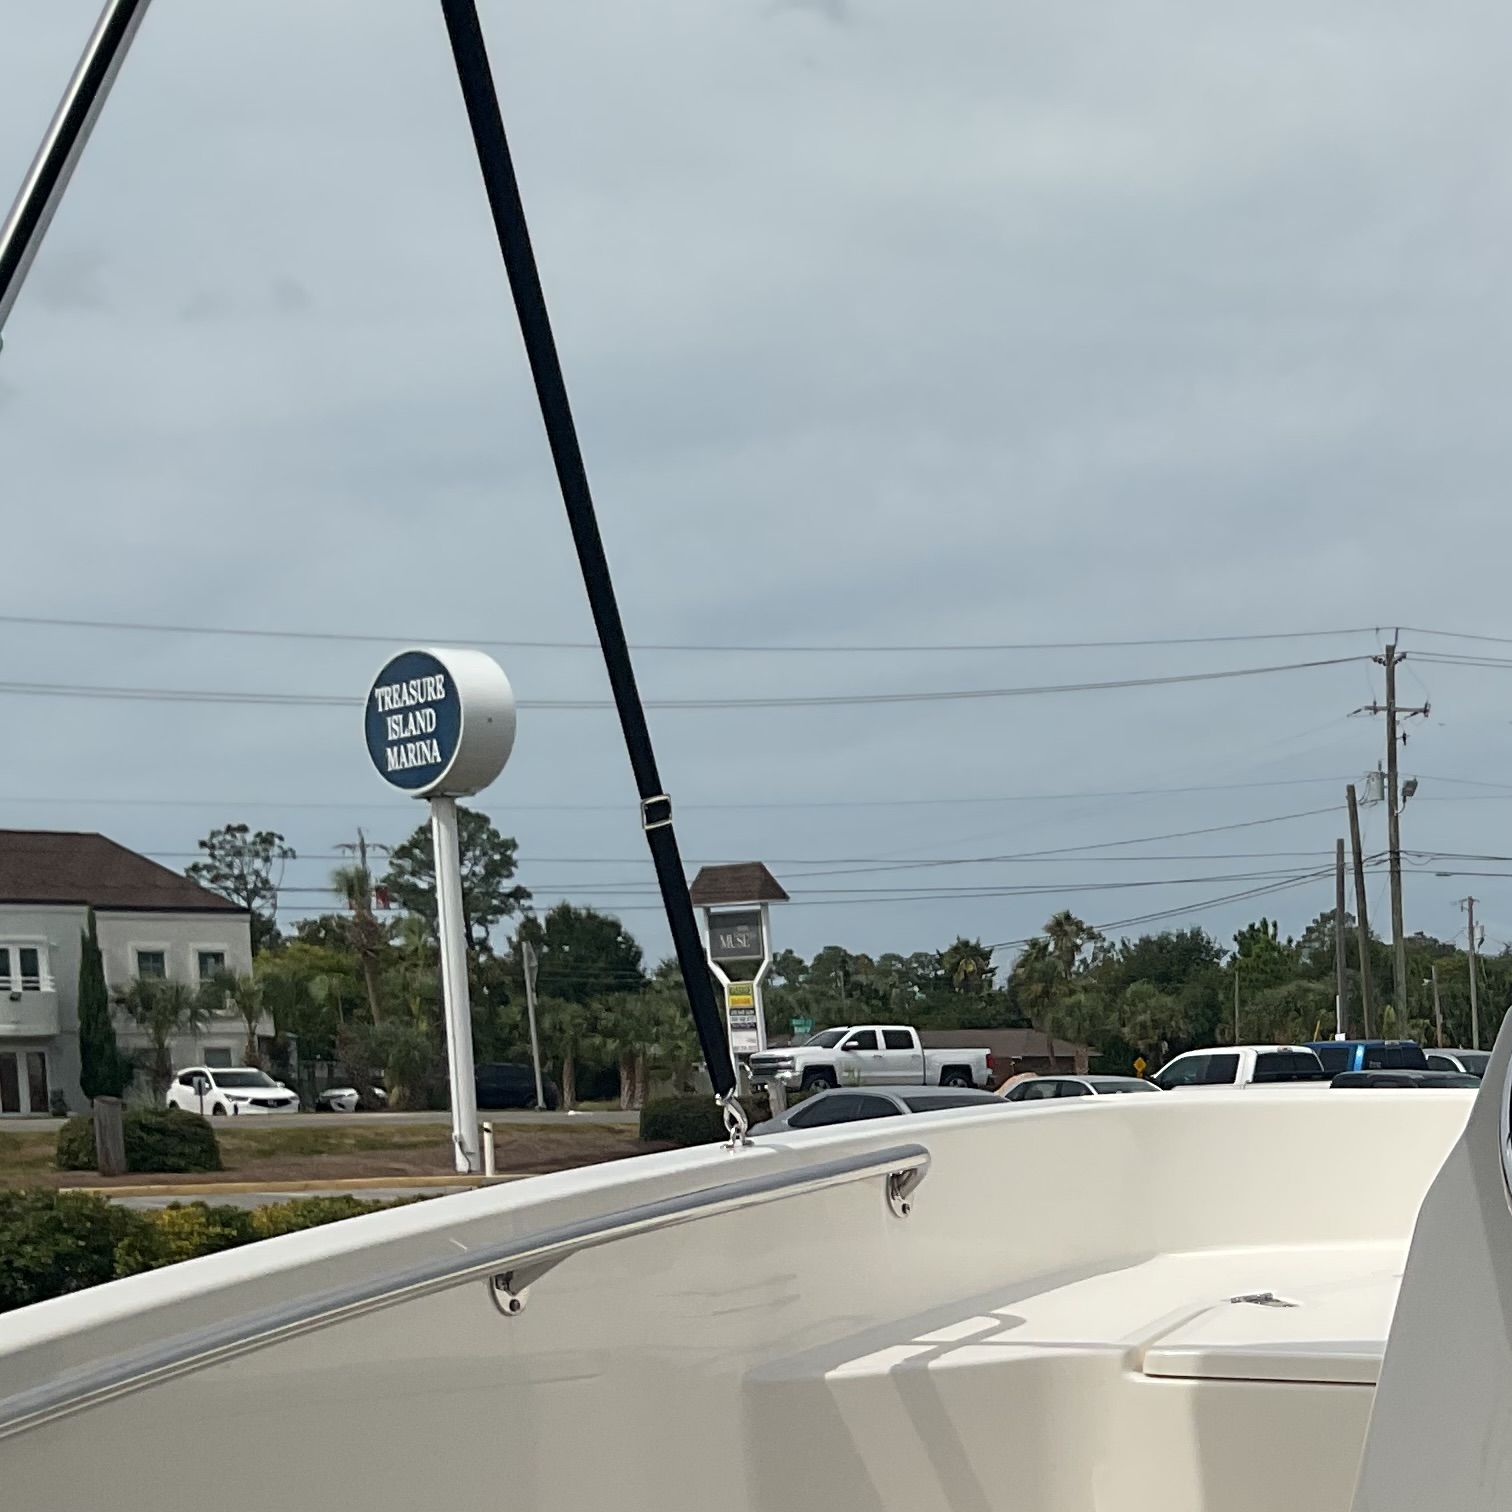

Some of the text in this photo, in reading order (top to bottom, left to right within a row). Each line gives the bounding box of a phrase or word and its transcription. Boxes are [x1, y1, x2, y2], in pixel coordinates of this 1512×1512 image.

[374, 673, 446, 712] TREASURE
[386, 707, 437, 741] ISLAND
[386, 738, 442, 772] MARINA
